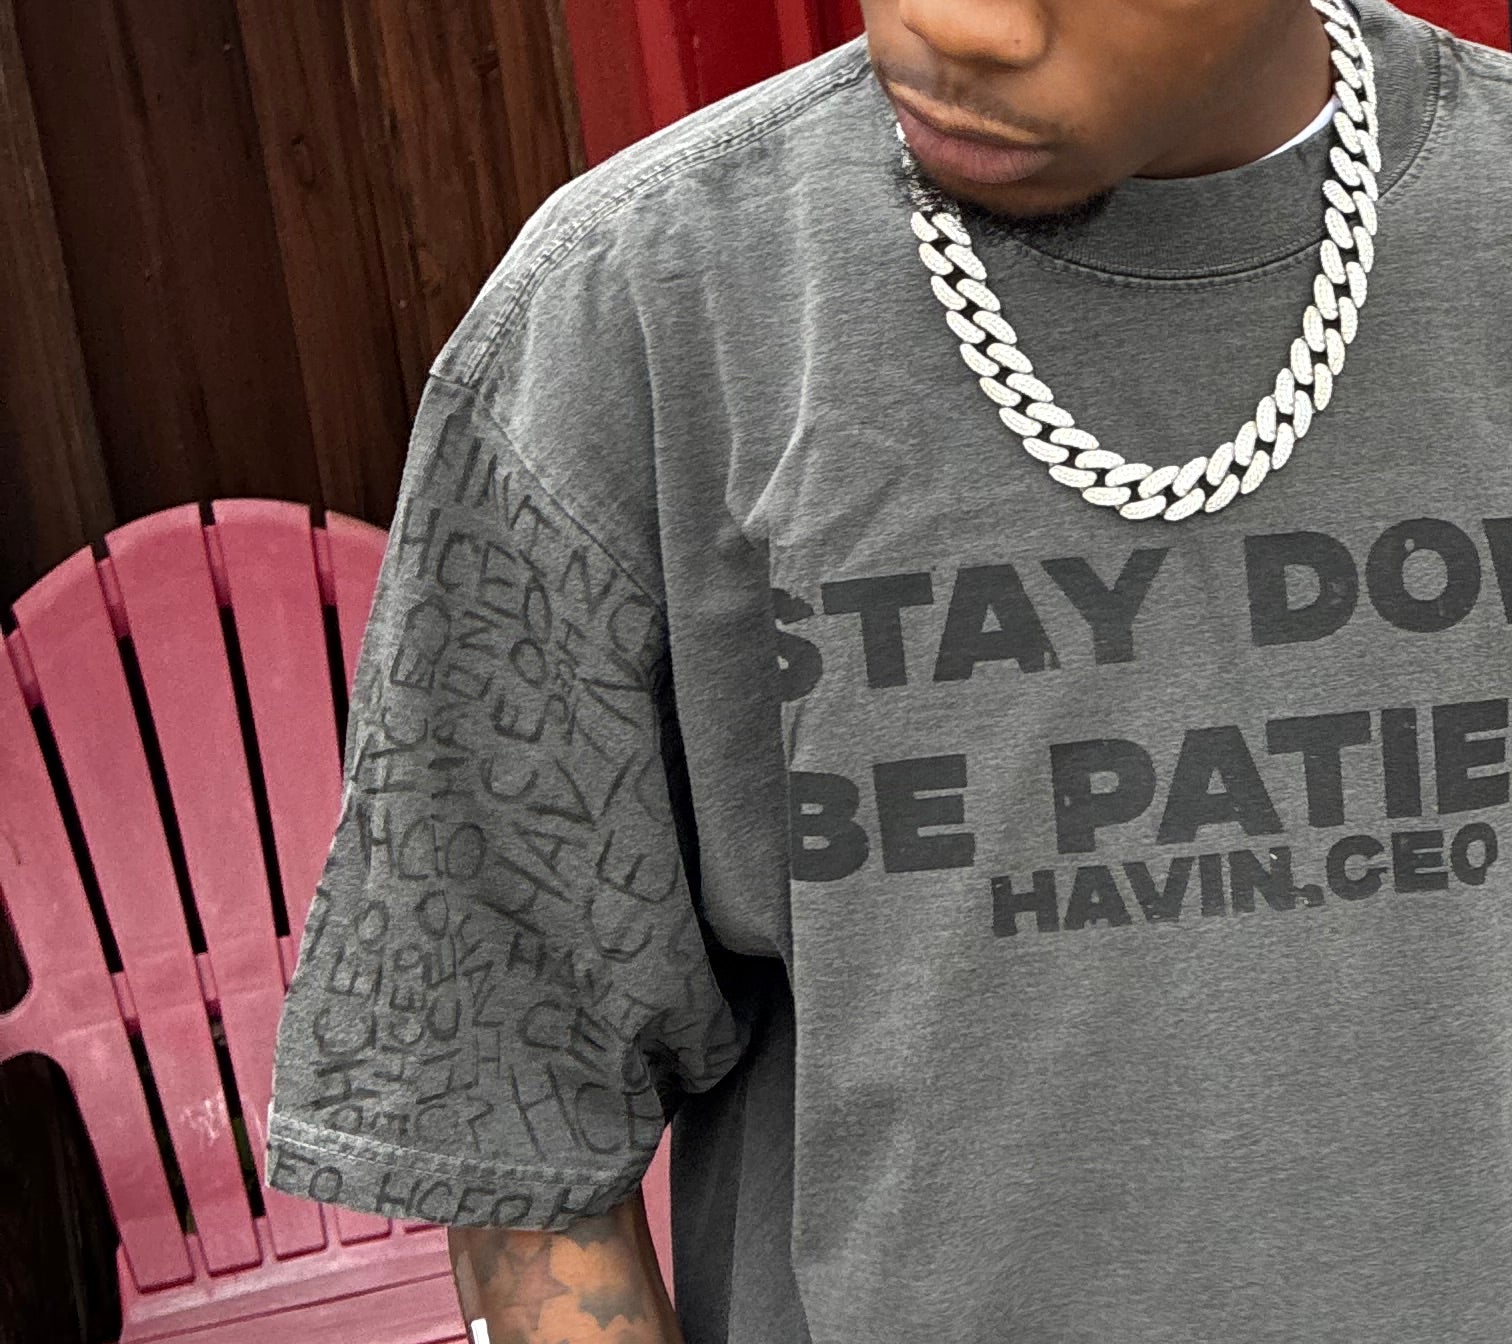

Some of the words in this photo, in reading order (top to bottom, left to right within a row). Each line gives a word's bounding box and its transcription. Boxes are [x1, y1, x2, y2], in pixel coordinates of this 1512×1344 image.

[770, 547, 1171, 704] STAY
[788, 754, 977, 884] BE
[991, 822, 1499, 937] HAVIN.CEO
